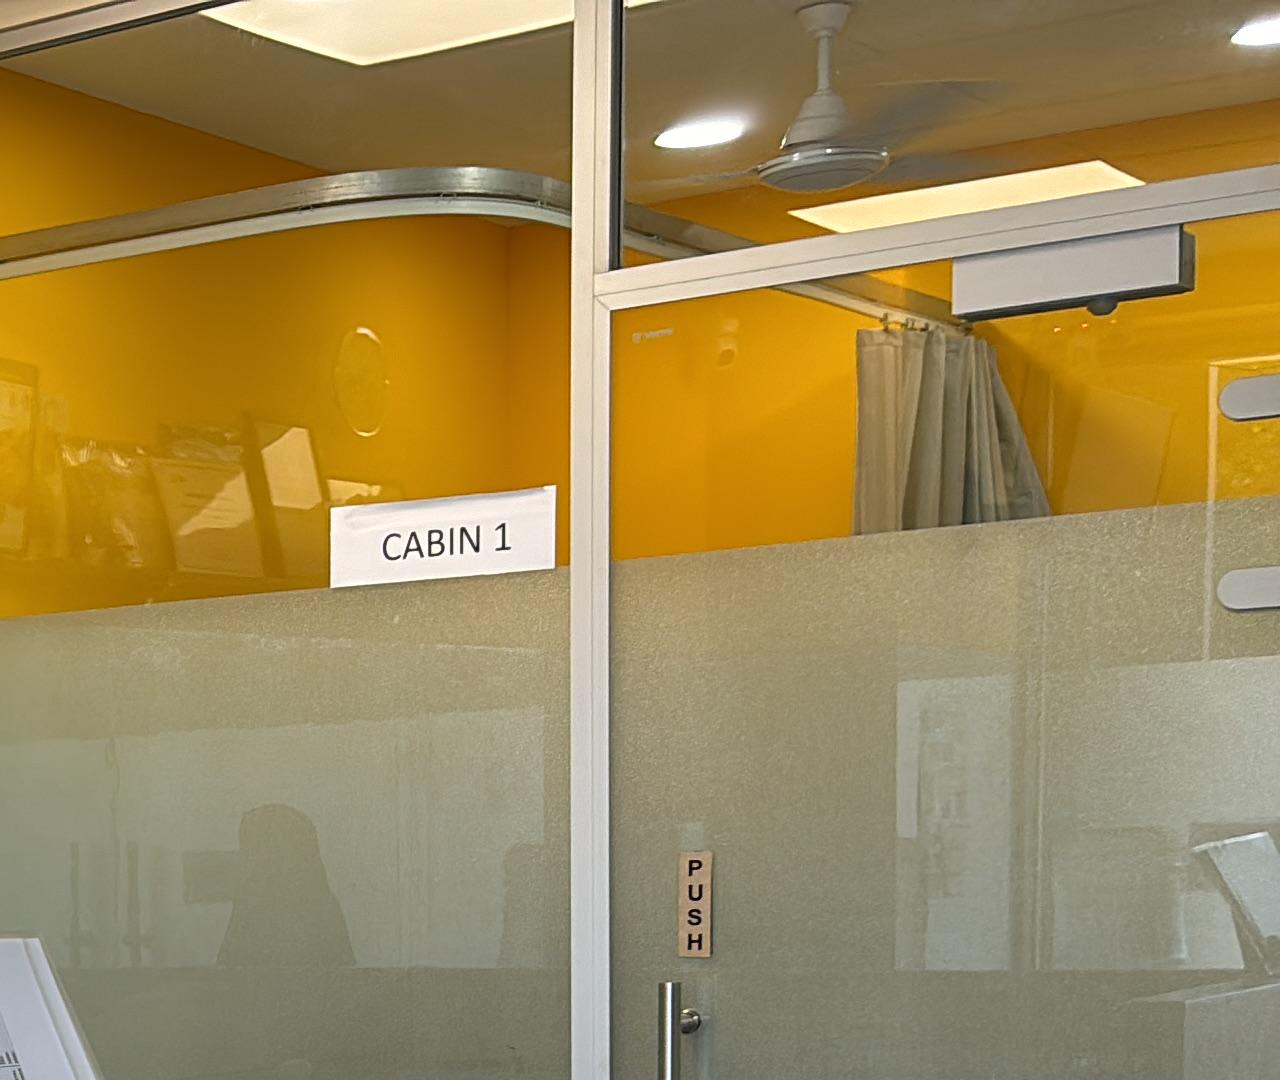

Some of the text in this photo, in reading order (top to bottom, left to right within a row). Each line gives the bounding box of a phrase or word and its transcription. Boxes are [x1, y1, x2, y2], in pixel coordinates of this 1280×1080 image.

[382, 522, 512, 561] CABIN 1
[687, 860, 703, 950] PUSH
